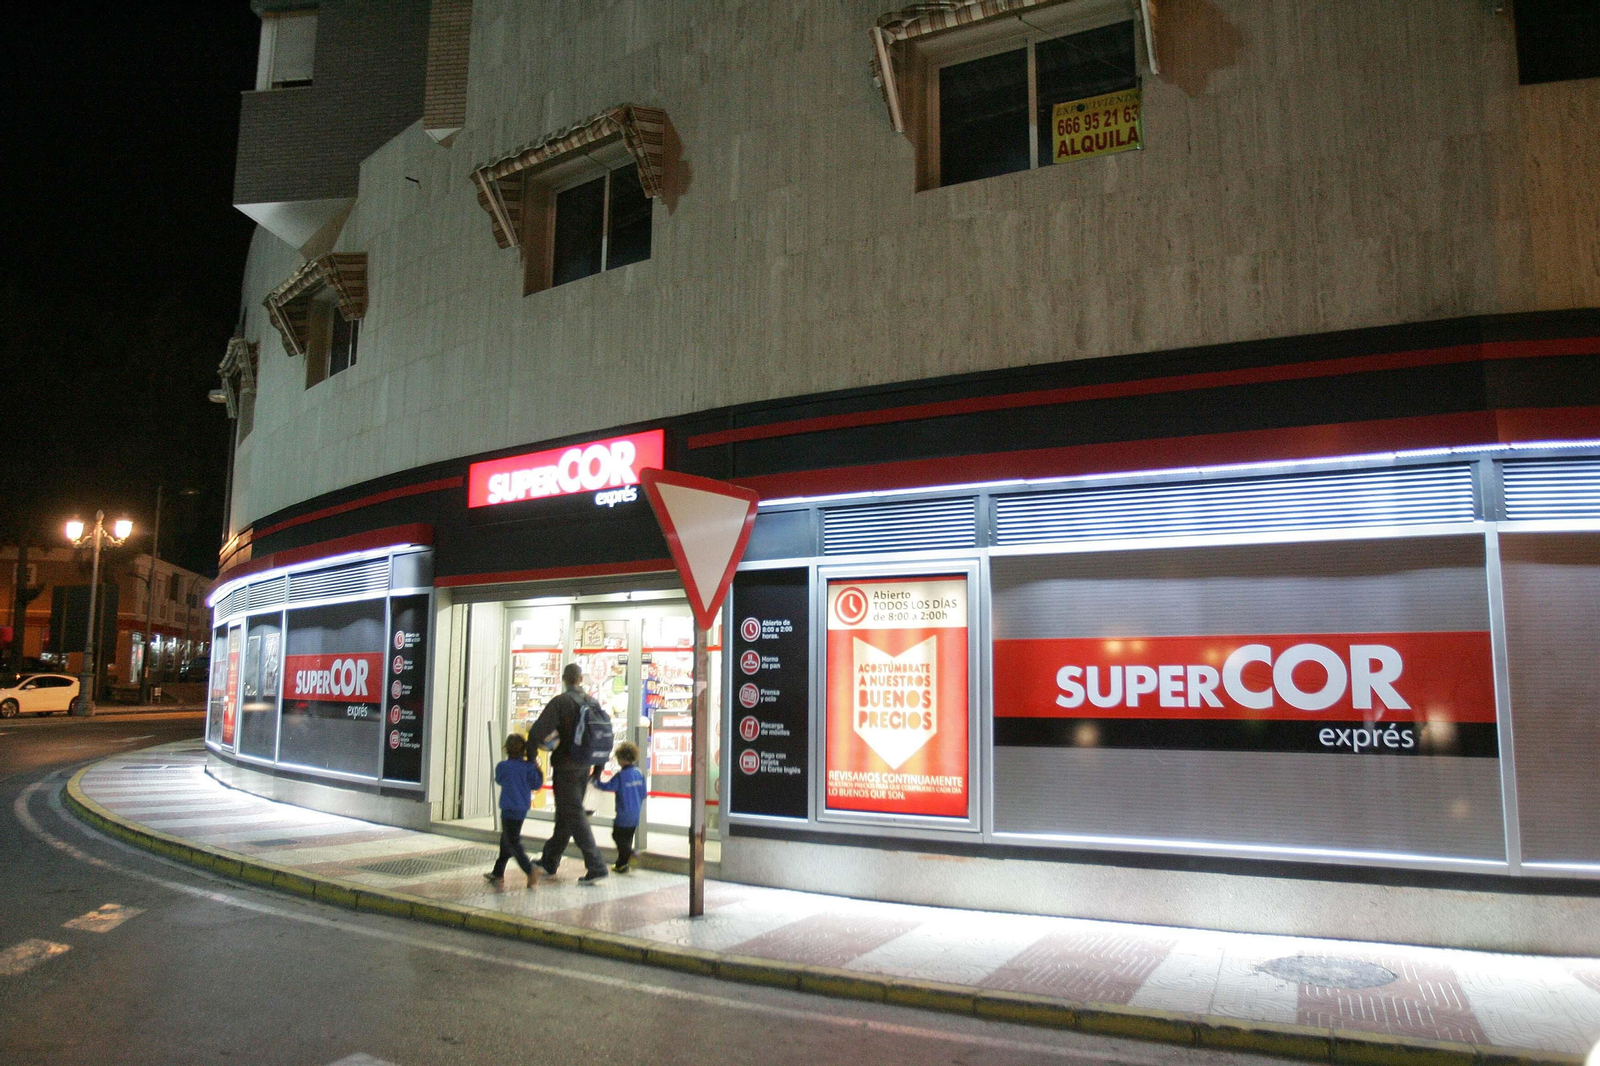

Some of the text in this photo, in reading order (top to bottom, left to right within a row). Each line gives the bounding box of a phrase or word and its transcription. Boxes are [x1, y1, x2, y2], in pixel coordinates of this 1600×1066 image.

[1057, 104, 1140, 136] 666 95 21 63
[1057, 126, 1140, 158] ALQUILA
[488, 440, 638, 504] SUPERCOR
[594, 485, 638, 507] exprés
[873, 590, 911, 600] Abierto
[873, 598, 957, 610] TODOS LOS DÍAS
[873, 612, 886, 621] de
[888, 612, 909, 621] 8:00
[920, 610, 948, 621] 2:00h
[858, 660, 931, 673] ACOSTÚMBRATE
[295, 658, 369, 696] SUPERCOR
[859, 675, 931, 687] A NUESTROS
[1055, 643, 1411, 711] SUPERCOR
[859, 690, 932, 709] BUENOS
[347, 703, 368, 720] exprés
[858, 710, 932, 731] PRECIOS
[1318, 722, 1415, 753] exprés
[828, 770, 963, 788] REVISAMOS CONTINUAMENTE
[828, 788, 837, 797] LO
[839, 789, 870, 798] BUENOS
[870, 790, 887, 799] QUE
